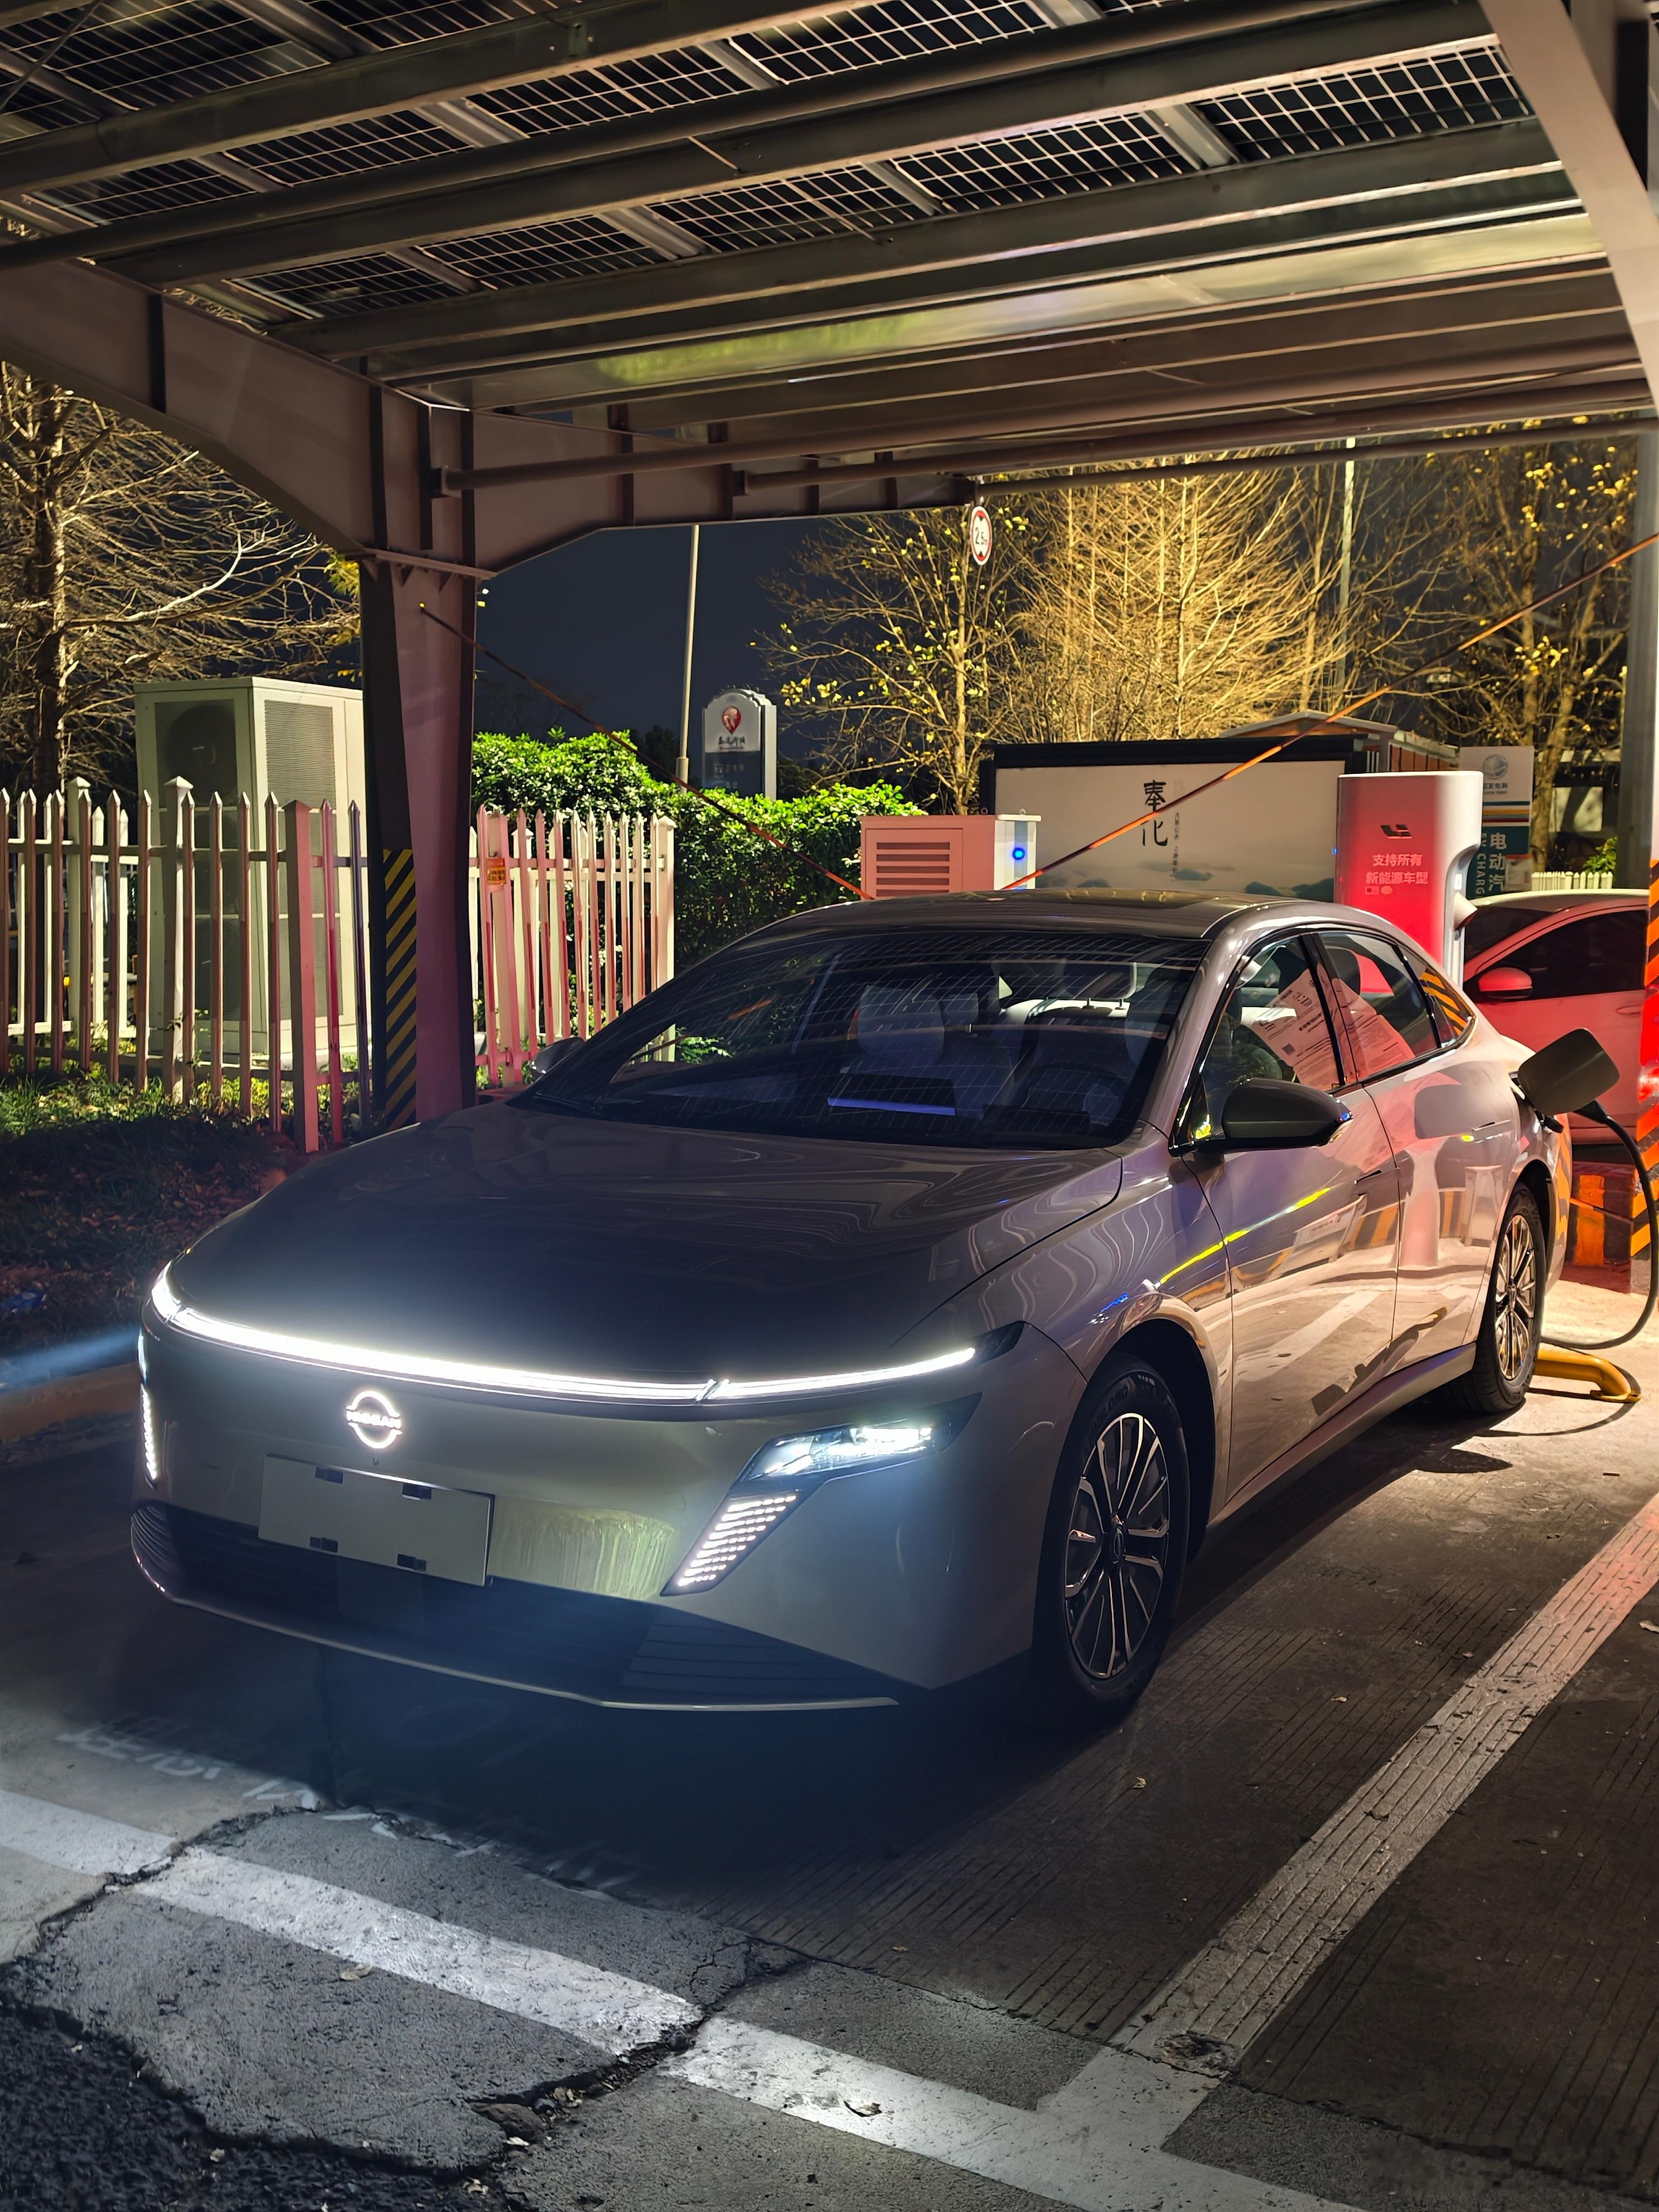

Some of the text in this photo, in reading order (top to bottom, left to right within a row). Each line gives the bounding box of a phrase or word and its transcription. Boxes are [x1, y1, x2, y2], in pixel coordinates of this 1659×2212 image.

[1141, 779, 1168, 846] 奉化
[1372, 853, 1423, 867] 支持所有
[1366, 871, 1428, 885] 新能源车型
[346, 1411, 401, 1429] NISSAN
